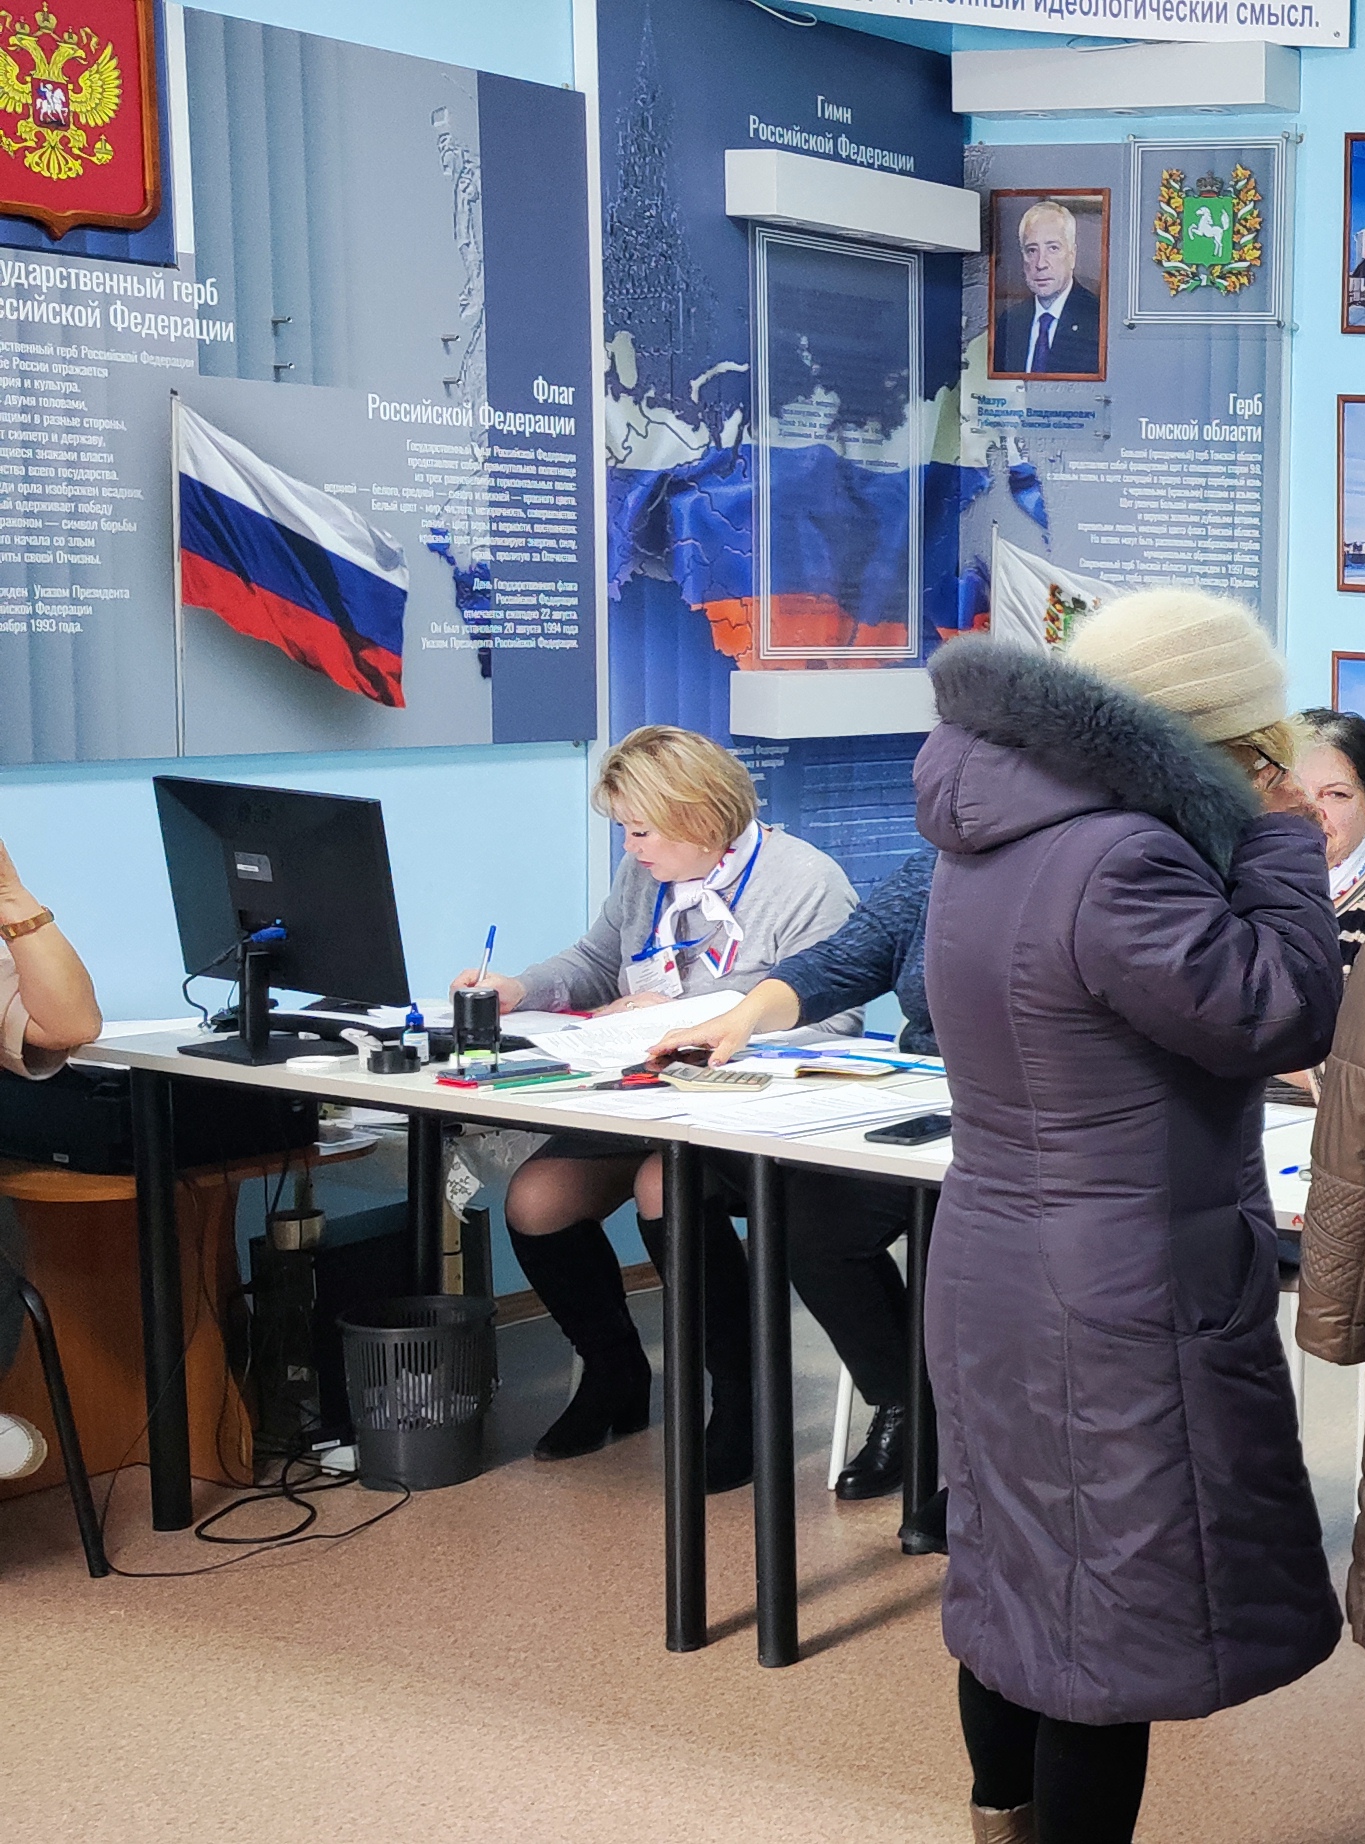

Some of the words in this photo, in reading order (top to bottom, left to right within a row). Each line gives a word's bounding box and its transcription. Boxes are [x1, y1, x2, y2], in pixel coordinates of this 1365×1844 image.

[1236, 4, 1320, 28] смысл.
[817, 95, 852, 124] Гимн
[750, 114, 834, 154] Российской
[838, 134, 914, 172] Федерации
[0, 260, 165, 301] ударственный
[172, 277, 219, 310] герб
[0, 294, 101, 329] сийской
[109, 300, 235, 345] Федерации
[0, 341, 53, 356] ственный
[56, 345, 78, 359] герб
[13, 357, 48, 372] России
[4, 394, 36, 407] двумя
[533, 376, 575, 405] Флаг
[367, 393, 473, 427] Российской
[479, 401, 576, 437] Федерации
[1228, 394, 1263, 419] Герб
[1138, 418, 1198, 442] Томской
[1203, 420, 1262, 443] области
[0, 447, 33, 458] щиеся
[81, 452, 113, 463] власти
[18, 483, 42, 495] орла
[72, 585, 129, 600] Президента
[30, 619, 56, 631] 1993
[59, 623, 83, 633] года.
